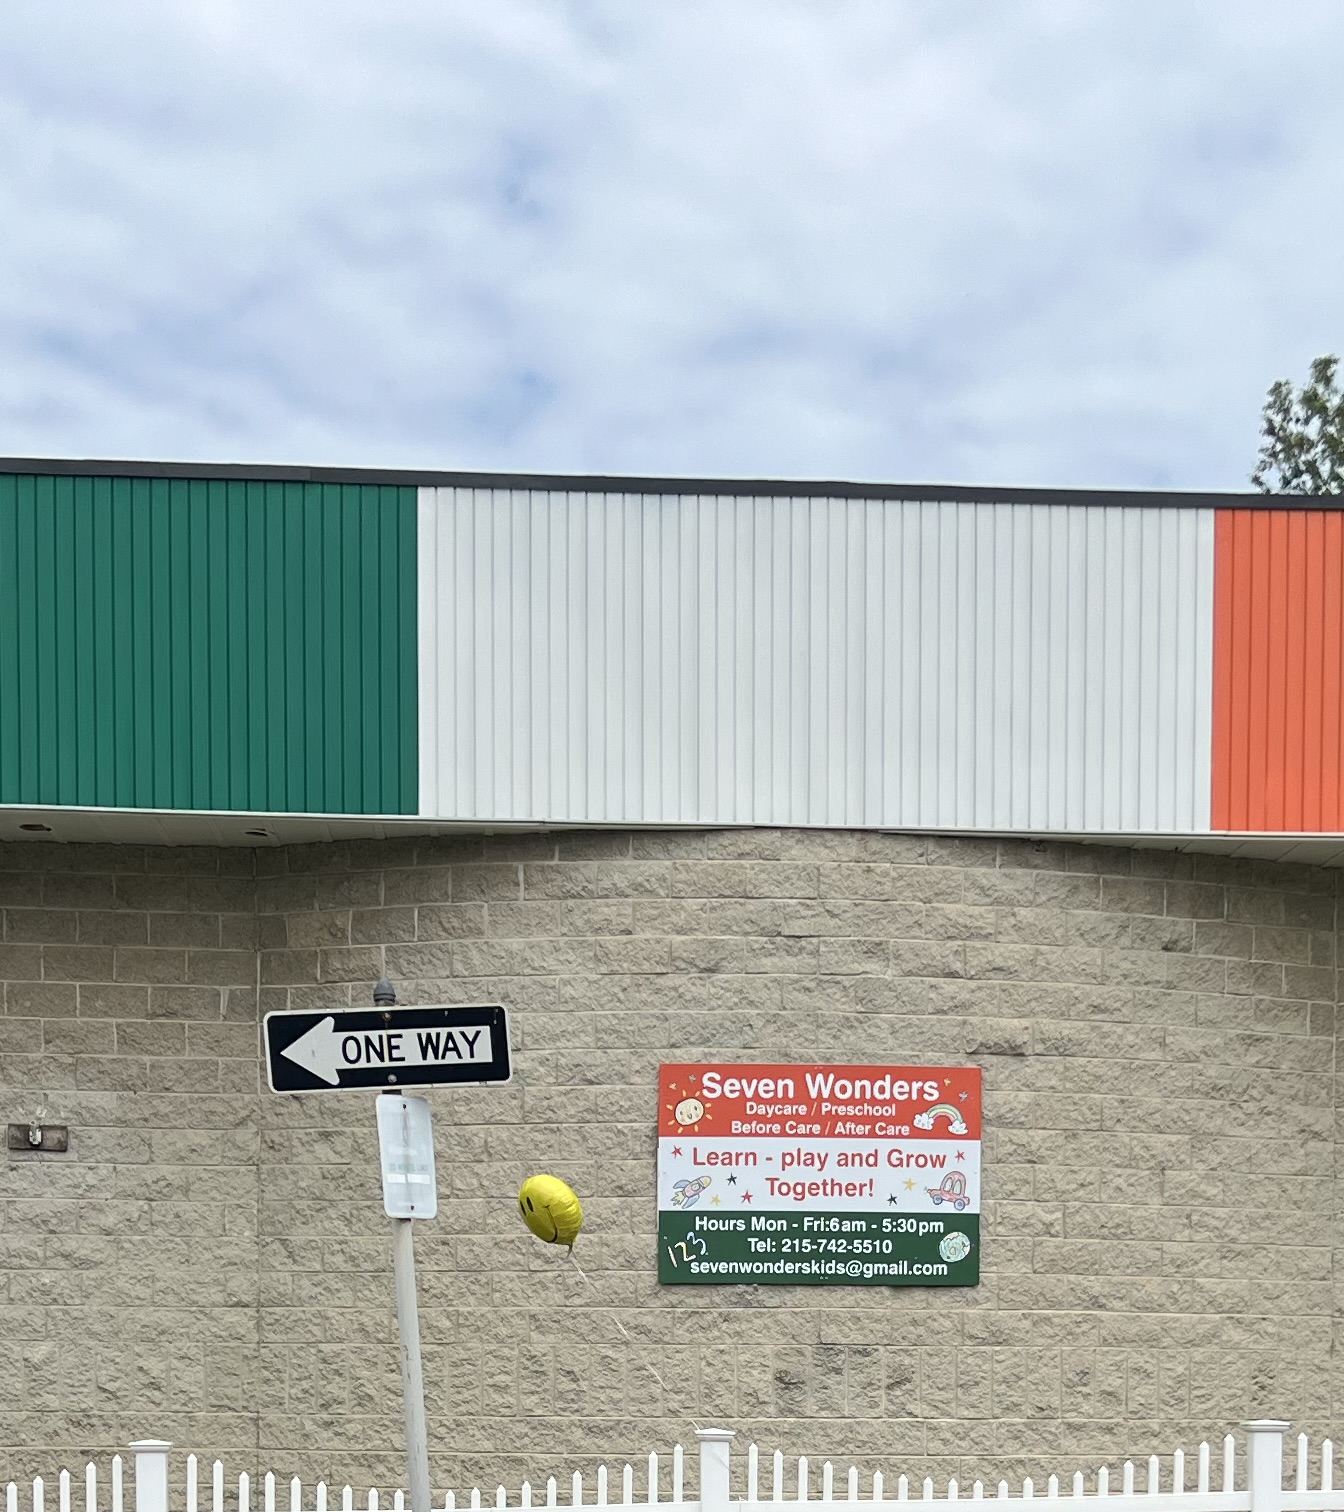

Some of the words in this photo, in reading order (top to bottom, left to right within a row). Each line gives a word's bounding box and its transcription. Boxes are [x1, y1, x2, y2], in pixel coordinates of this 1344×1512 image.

[342, 1034, 405, 1064] ONE
[416, 1030, 481, 1061] WAY
[701, 1071, 794, 1099] Seven
[805, 1073, 940, 1101] Wonders
[746, 1102, 807, 1118] Daycare
[821, 1103, 896, 1117] Preschool
[731, 1120, 781, 1134] Before
[785, 1121, 821, 1135] Care
[834, 1122, 871, 1135] After
[875, 1122, 910, 1136] Care
[692, 1147, 757, 1167] Learn
[781, 1148, 829, 1172] play
[836, 1149, 878, 1168] and
[886, 1150, 946, 1169] Grow
[765, 1177, 875, 1202] Together!
[695, 1217, 746, 1233] Hours
[751, 1217, 787, 1232] Mon
[882, 1219, 944, 1237] 5:30pm
[748, 1238, 776, 1252] Tel:
[781, 1238, 893, 1254] 215-742-5510
[690, 1260, 948, 1278] sevenwonderskids@gmail.com
